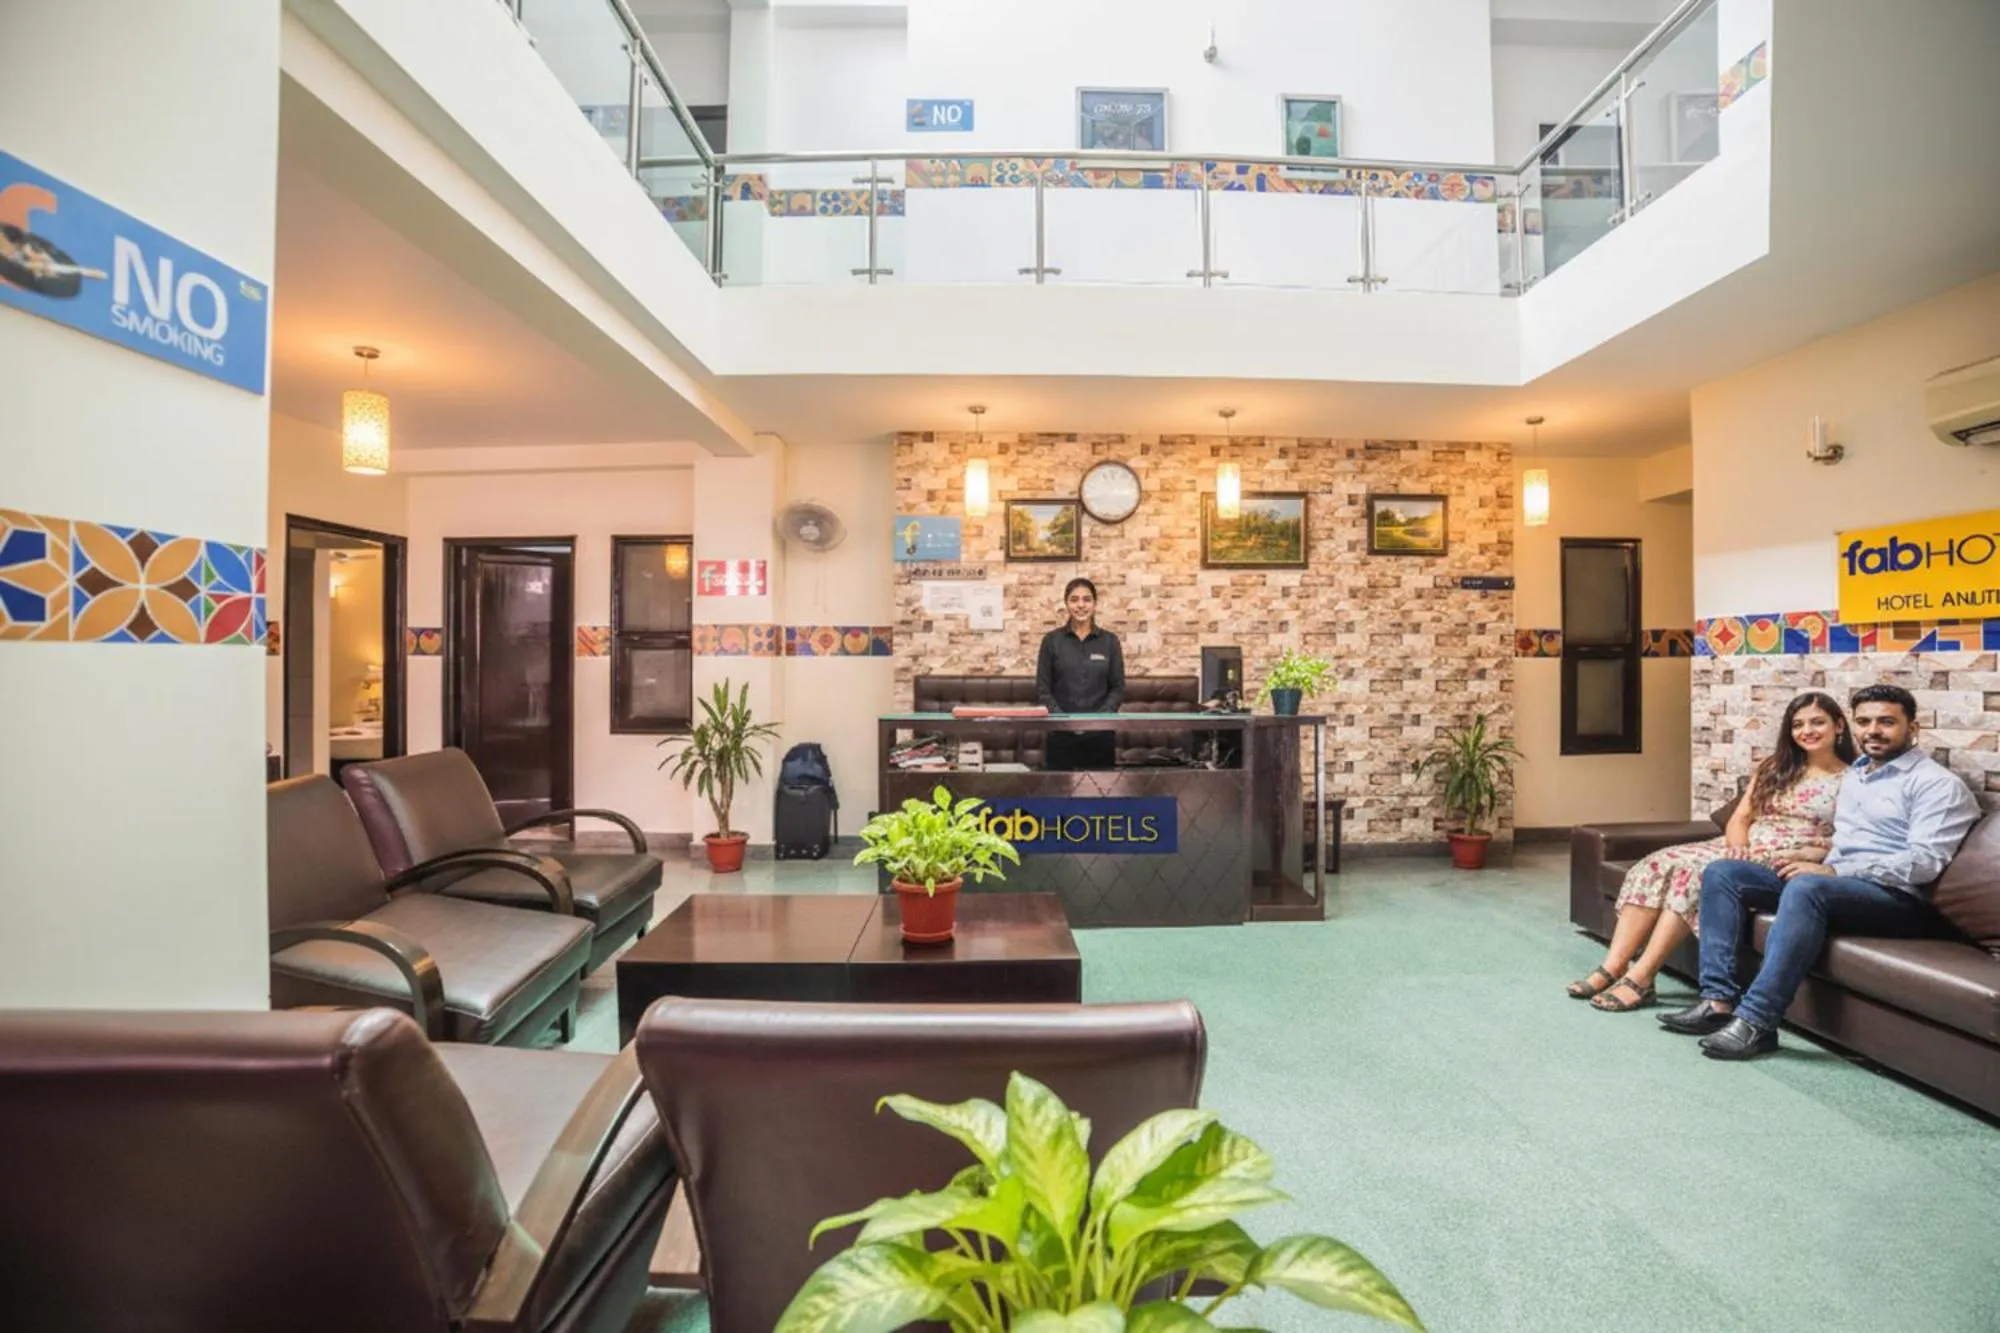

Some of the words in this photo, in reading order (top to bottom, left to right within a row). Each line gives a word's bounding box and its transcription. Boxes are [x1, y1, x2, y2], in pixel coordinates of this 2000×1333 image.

[932, 104, 962, 125] NO
[113, 235, 229, 341] NO
[110, 303, 225, 366] SMOKING
[1841, 533, 2000, 576] fabHO
[1876, 593, 1934, 610] HOTEL
